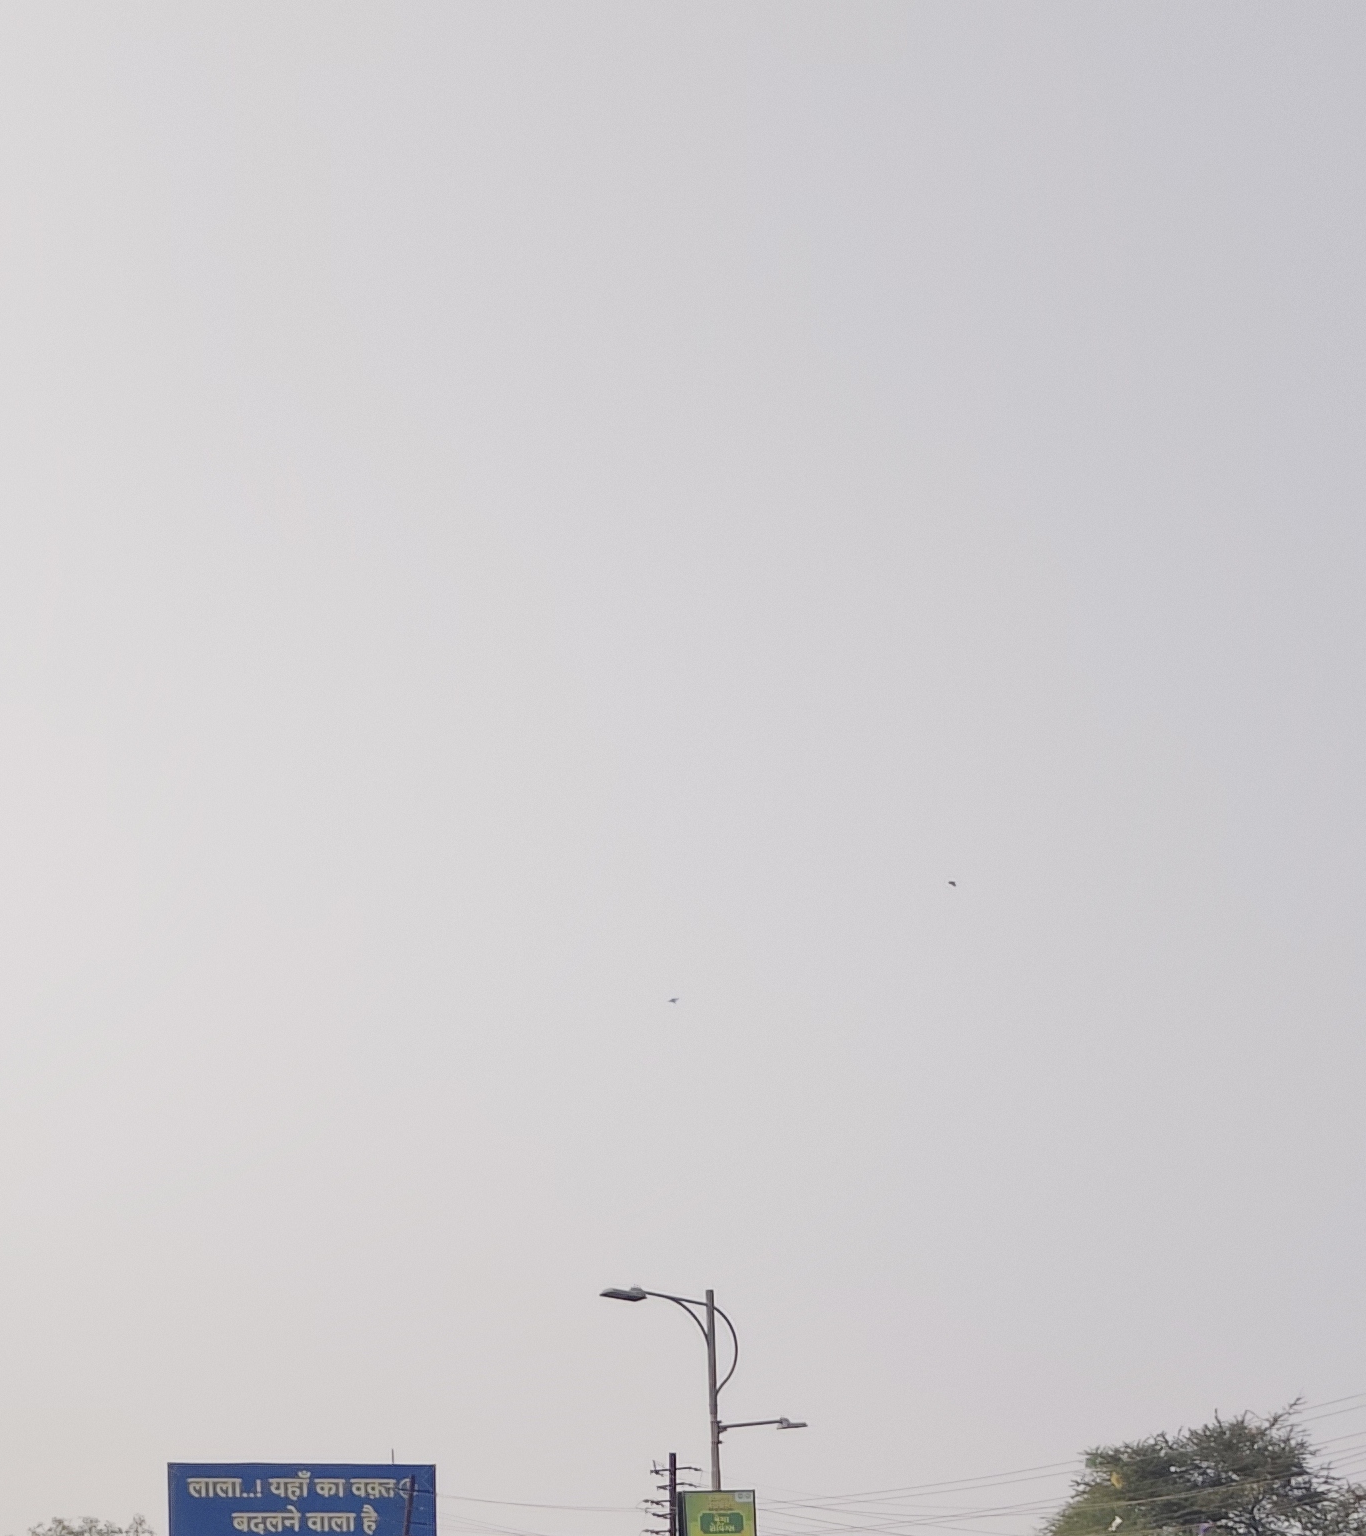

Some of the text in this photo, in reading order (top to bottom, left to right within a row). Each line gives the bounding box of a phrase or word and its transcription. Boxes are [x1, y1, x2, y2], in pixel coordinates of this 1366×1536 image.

[268, 1470, 311, 1500] यहाँ
[314, 1478, 345, 1498] का
[232, 1504, 379, 1535] बदलने वाला है
